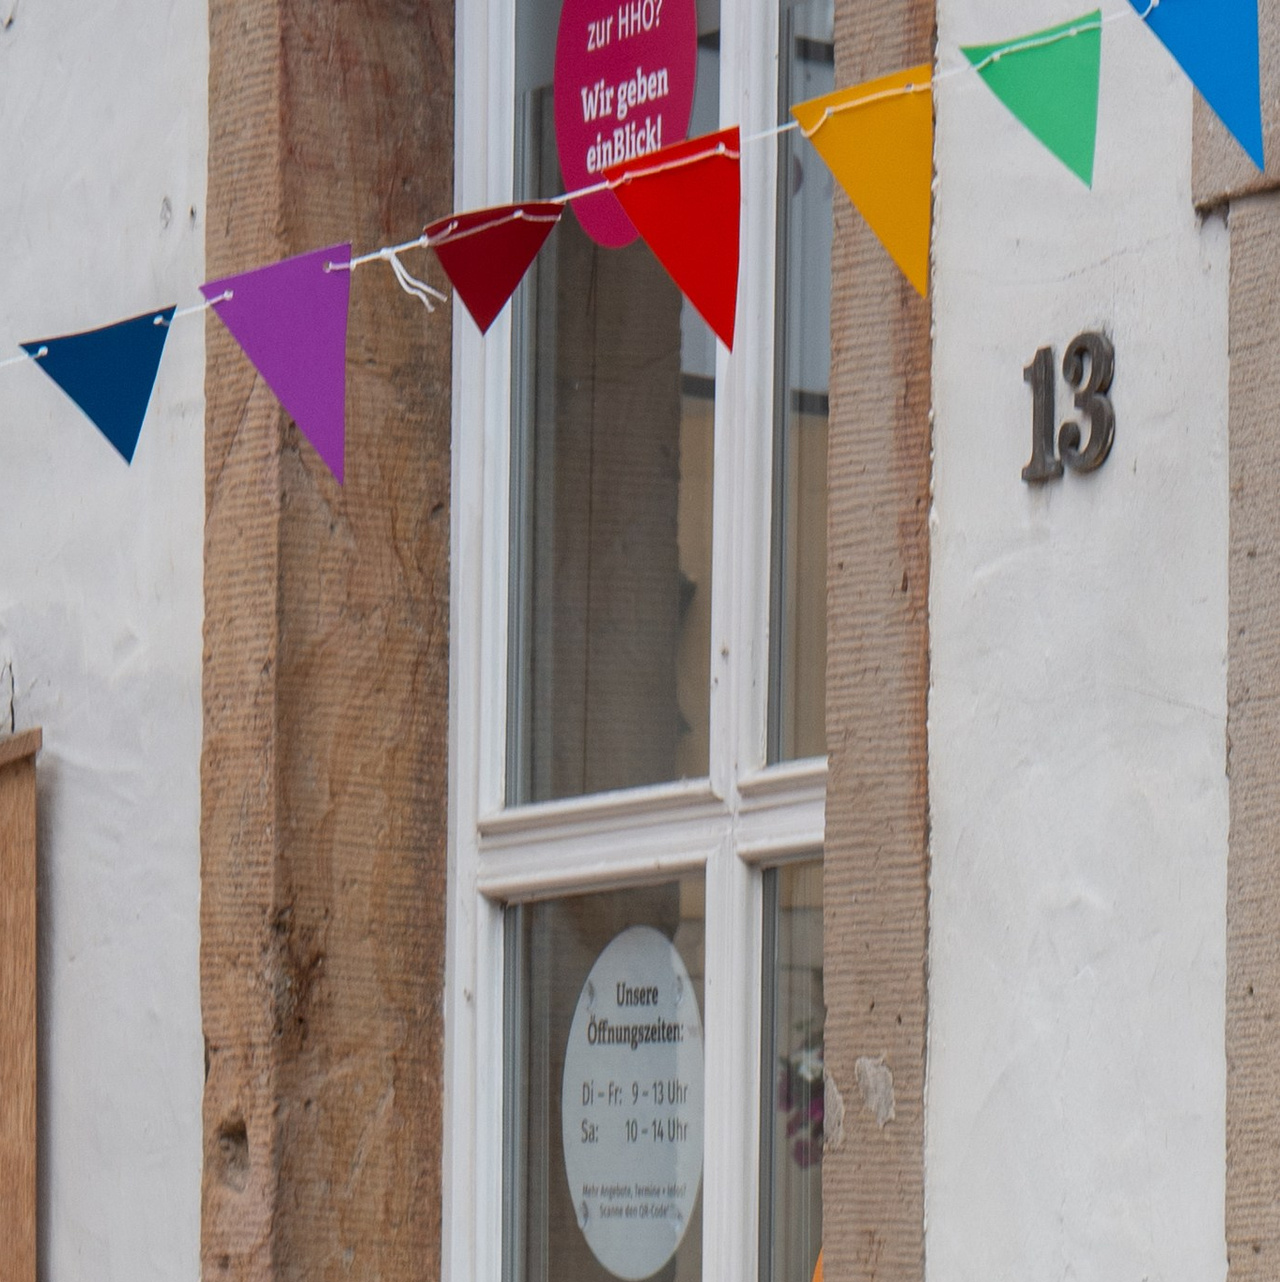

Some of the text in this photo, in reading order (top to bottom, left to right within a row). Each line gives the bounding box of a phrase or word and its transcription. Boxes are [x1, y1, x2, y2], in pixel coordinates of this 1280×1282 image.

[587, 0, 663, 51] zur HHO?
[581, 66, 669, 122] Wir geben
[586, 114, 663, 173] einBlick!
[1022, 331, 1116, 482] 13
[616, 982, 659, 1006] Unsere
[587, 1016, 684, 1050] Öffnungszeiten:
[582, 1080, 595, 1106] Di
[632, 1082, 638, 1105] 9
[652, 1081, 664, 1105] 13
[668, 1080, 688, 1104] Uhr
[581, 1121, 598, 1144] Sa:
[625, 1119, 638, 1143] 10
[652, 1119, 664, 1142] 14
[668, 1119, 688, 1143] Uhr
